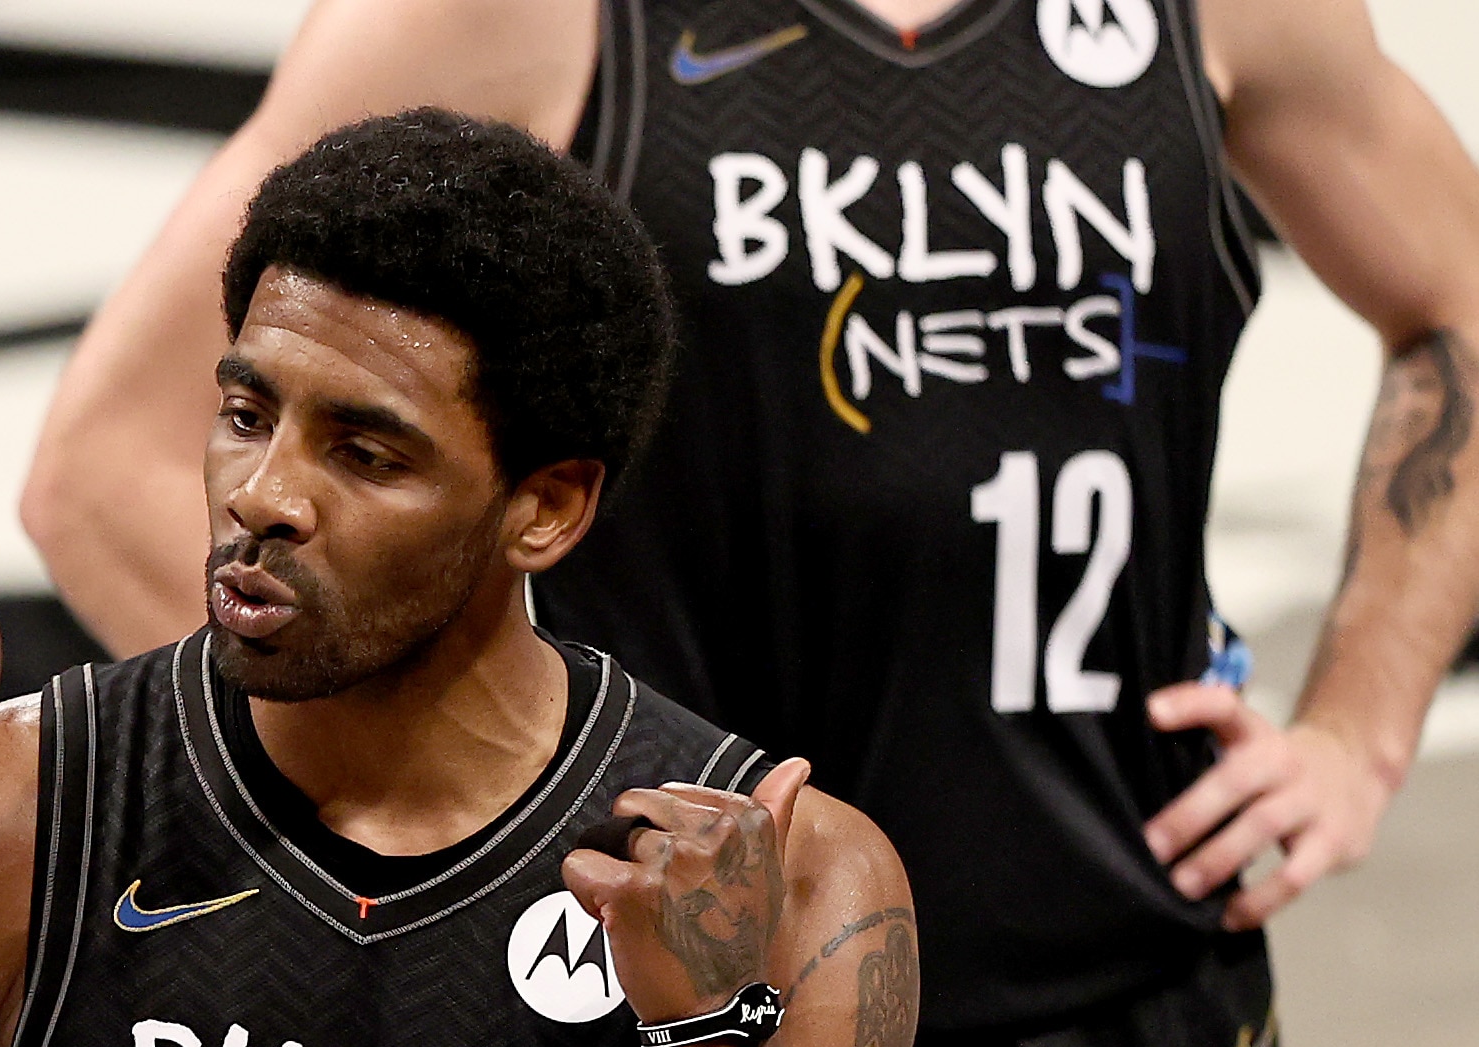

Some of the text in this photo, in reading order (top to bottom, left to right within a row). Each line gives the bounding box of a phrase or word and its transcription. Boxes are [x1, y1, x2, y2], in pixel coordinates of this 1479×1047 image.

[707, 142, 1157, 294] BKLYN
[970, 449, 1133, 714] 12
[647, 1029, 672, 1045] VIII
